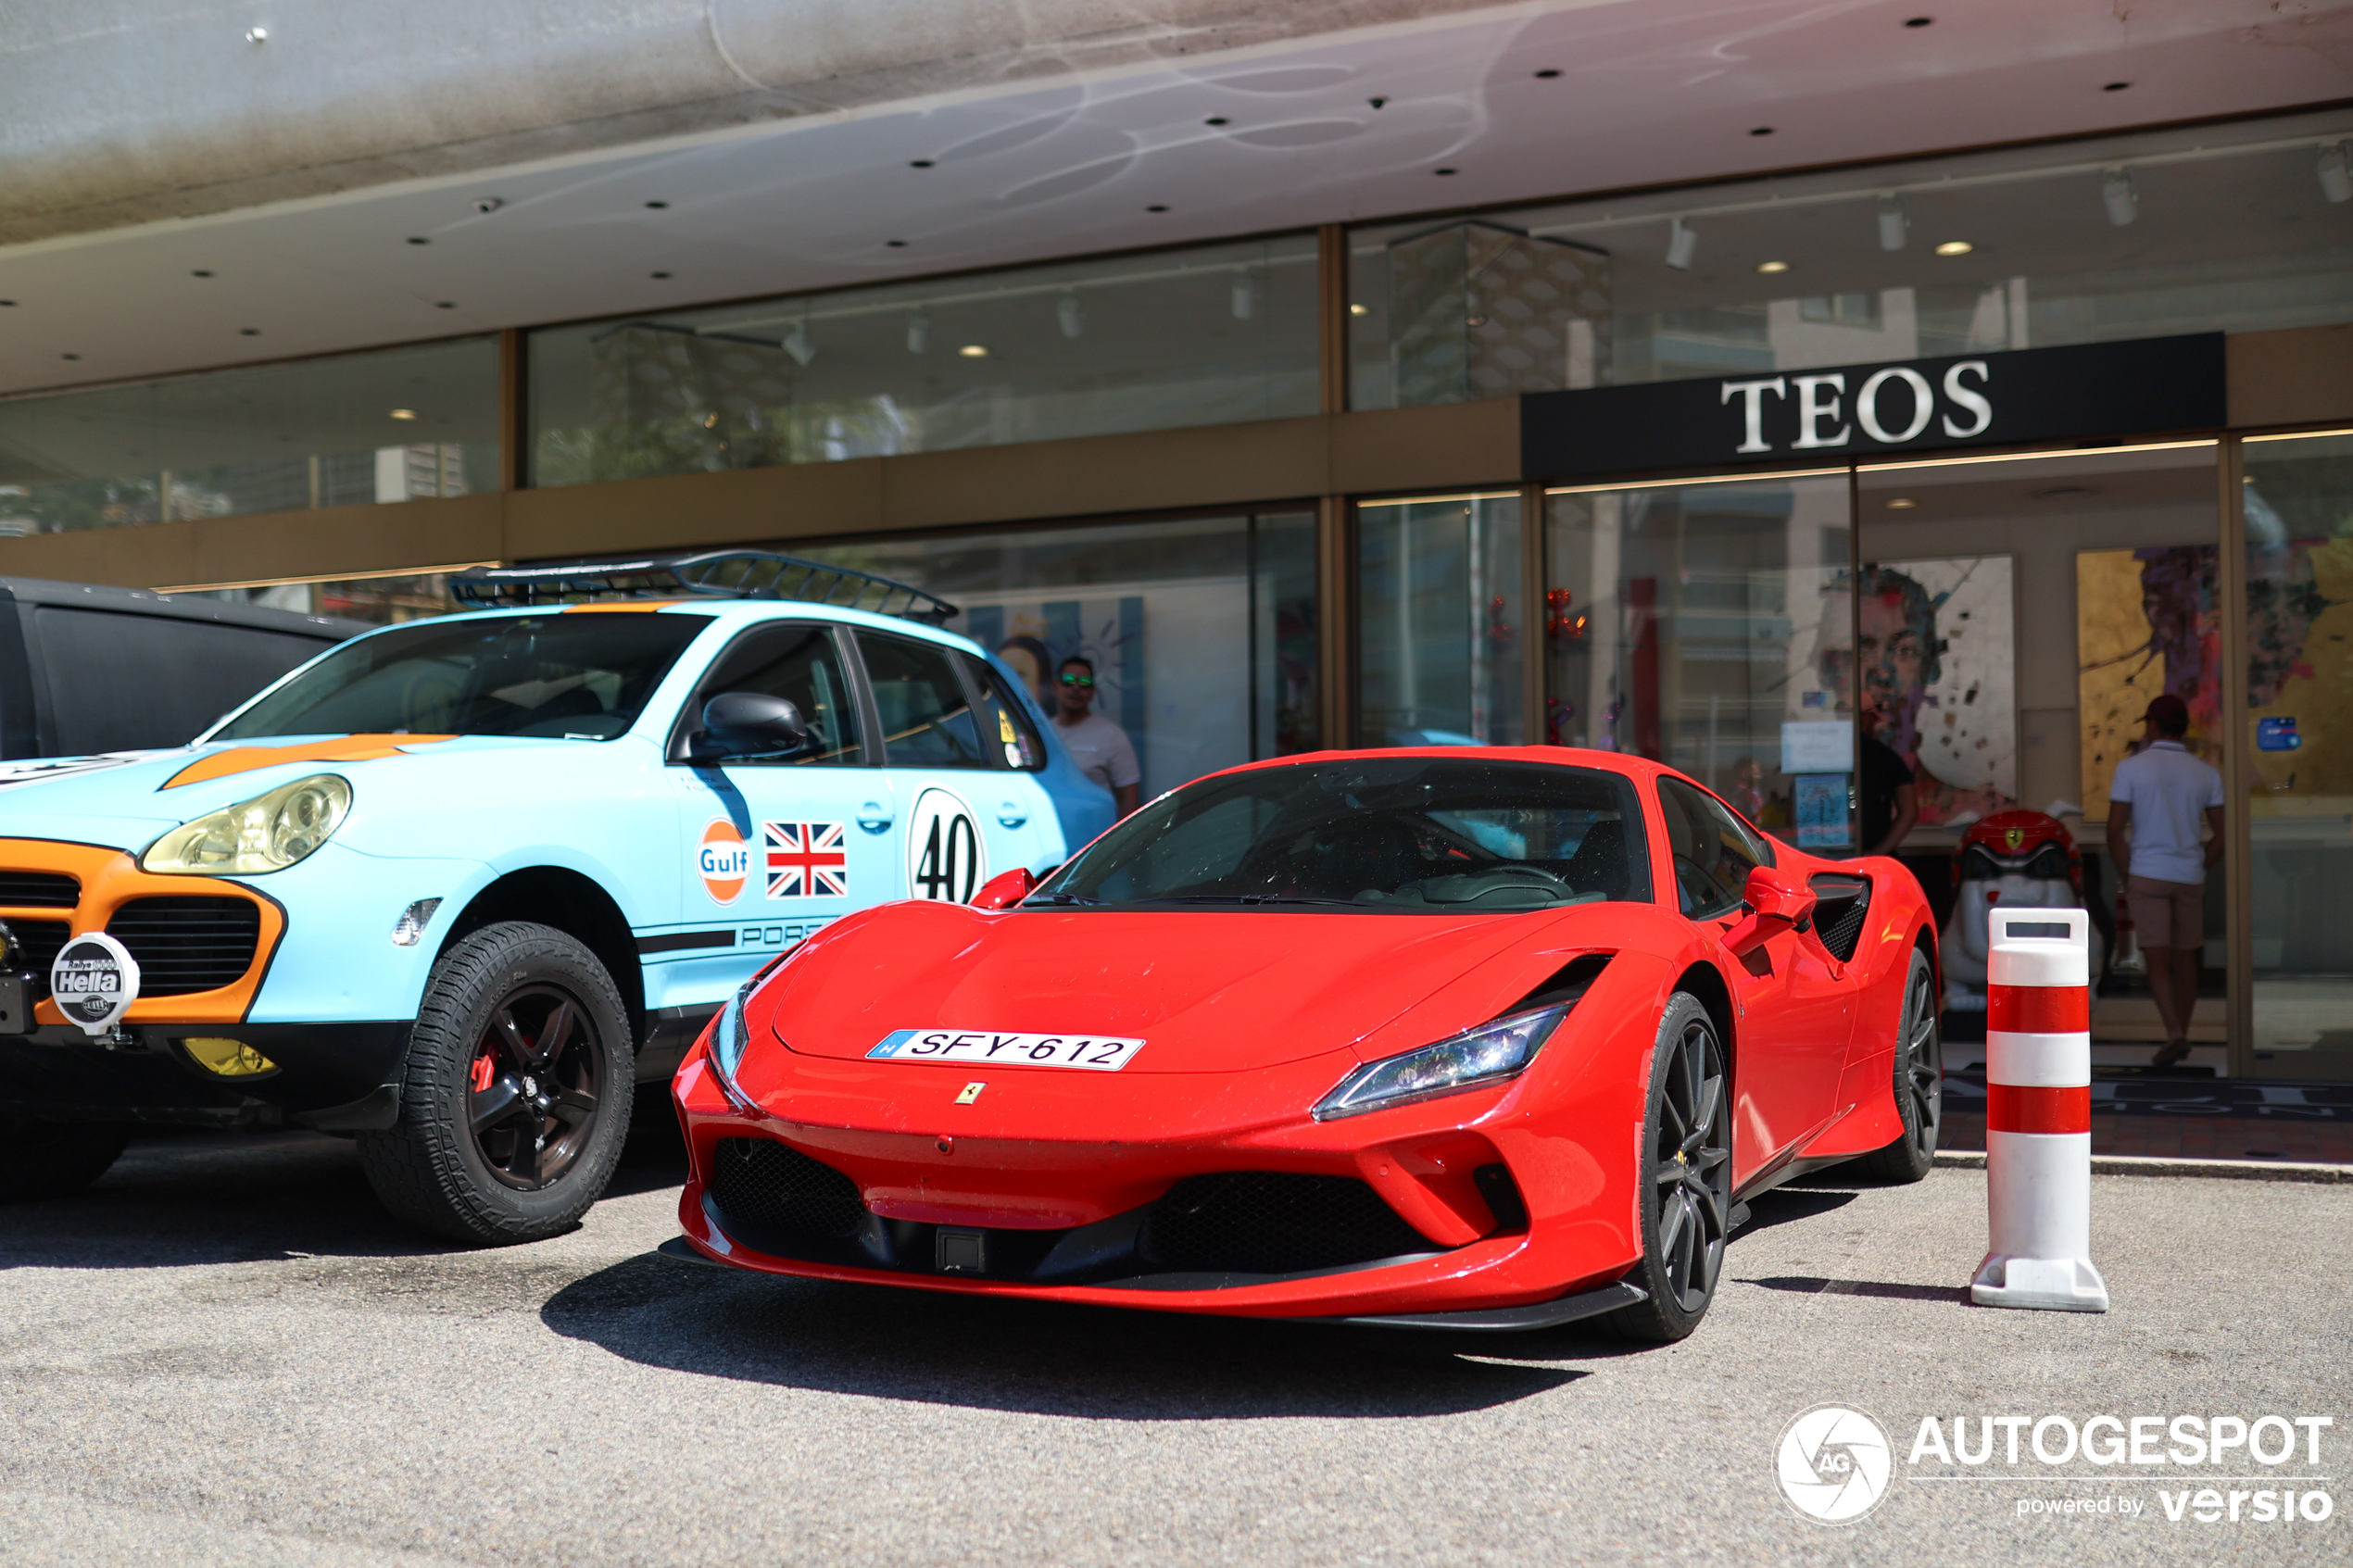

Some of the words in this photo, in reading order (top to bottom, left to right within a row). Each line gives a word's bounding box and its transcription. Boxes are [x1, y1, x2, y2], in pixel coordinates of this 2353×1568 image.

[1720, 360, 1993, 453] TEOS
[700, 848, 748, 872] Gulf
[915, 813, 976, 906] 40
[69, 960, 92, 971] Rallye
[59, 972, 118, 992] Hella
[911, 1034, 1125, 1064] SFY-612
